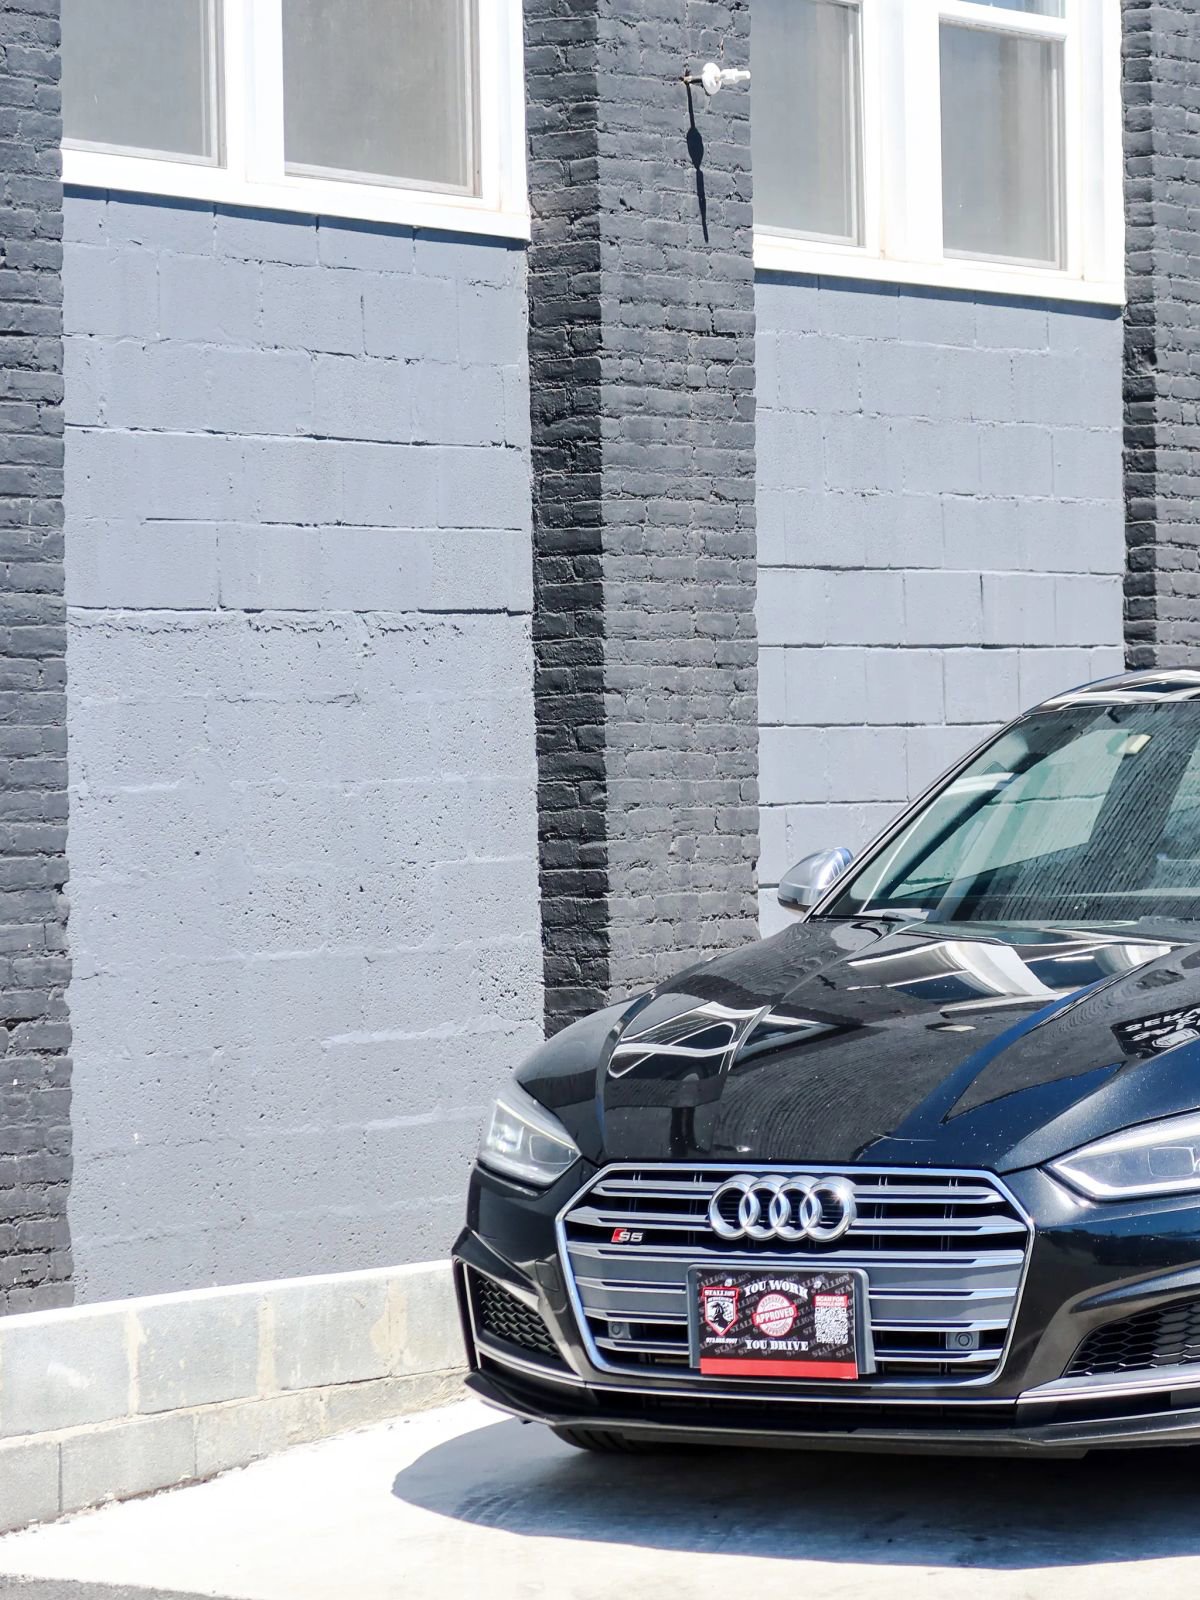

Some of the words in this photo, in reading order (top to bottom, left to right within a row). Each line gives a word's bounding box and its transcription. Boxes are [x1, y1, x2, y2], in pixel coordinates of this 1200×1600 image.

[744, 1281, 767, 1298] YOU
[769, 1280, 809, 1300] WORK
[755, 1308, 795, 1325] APPROVED
[745, 1339, 767, 1350] YOU
[770, 1340, 809, 1351] DRIVE
